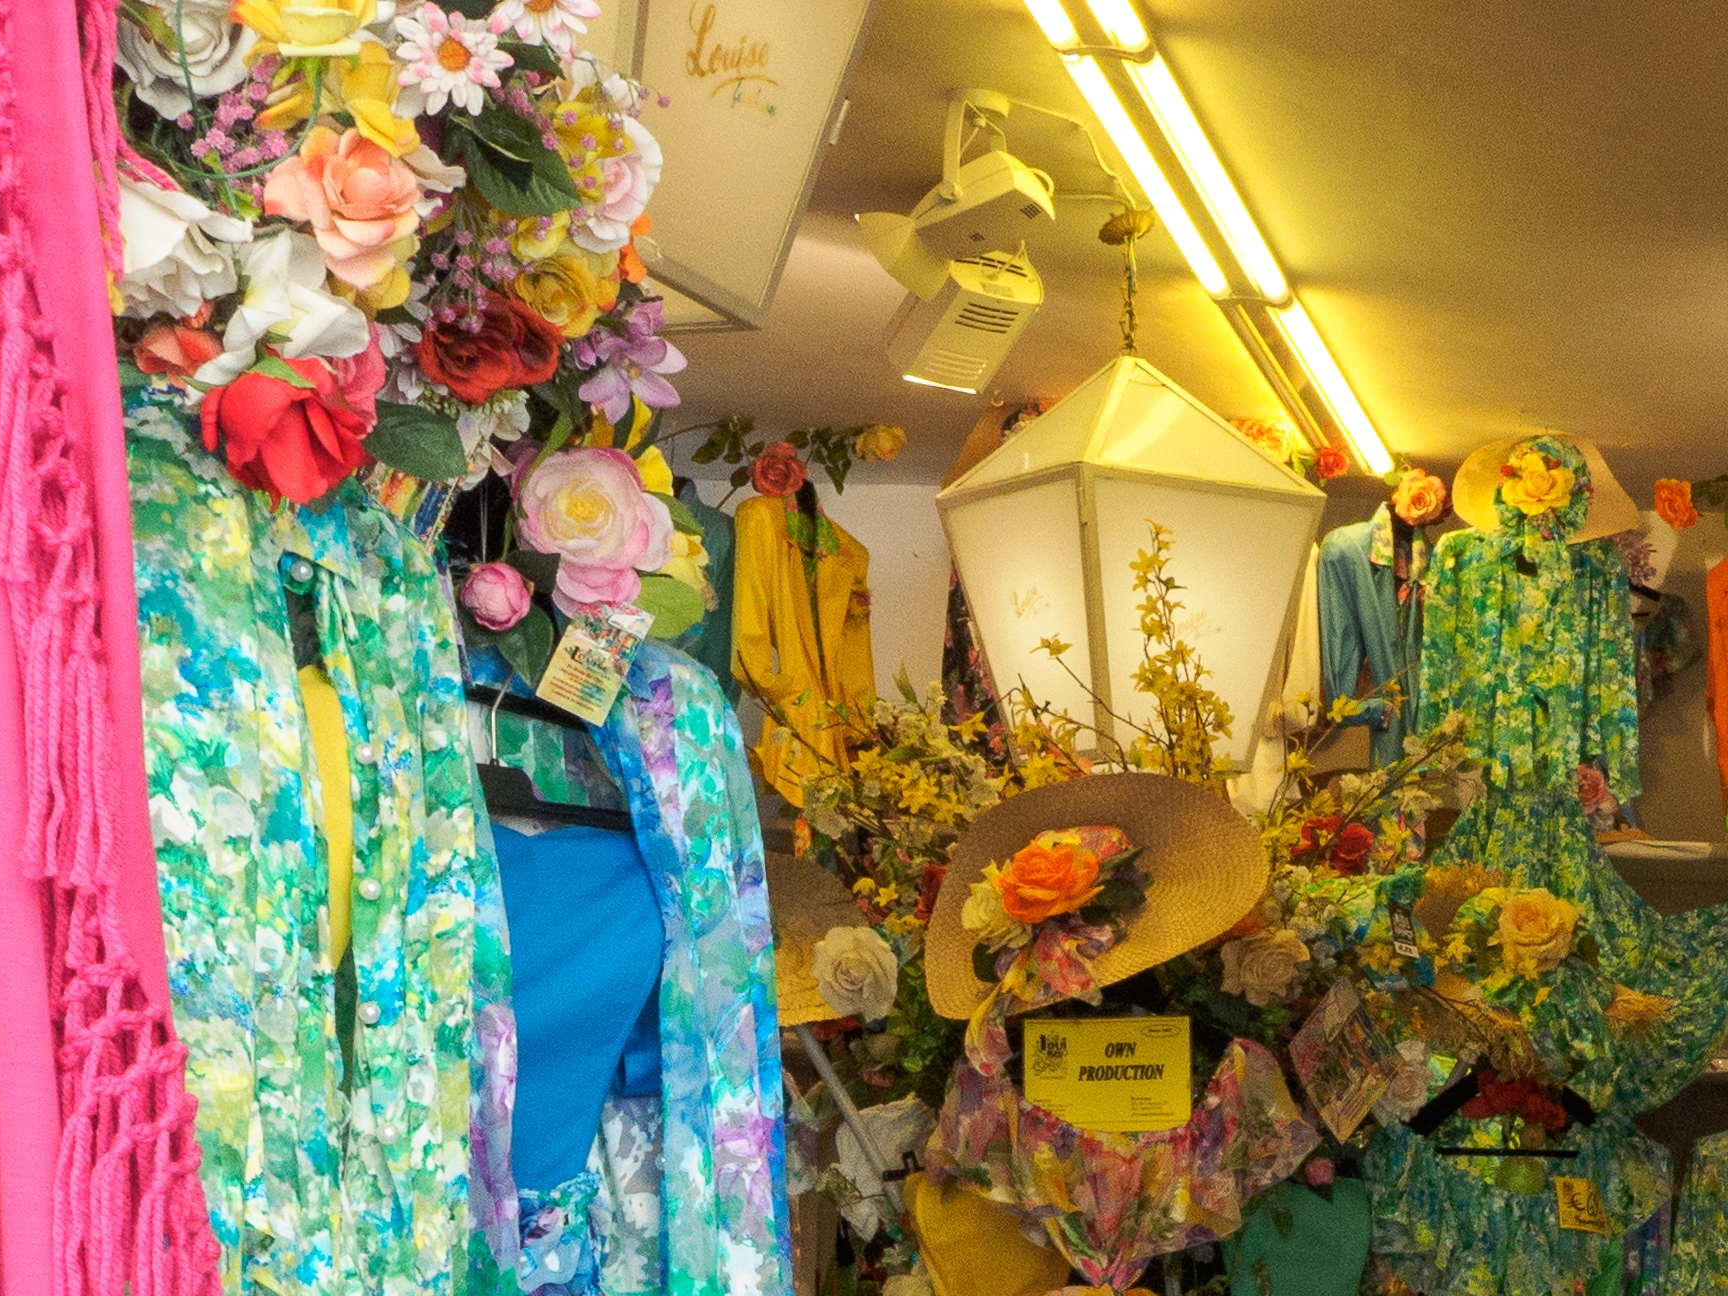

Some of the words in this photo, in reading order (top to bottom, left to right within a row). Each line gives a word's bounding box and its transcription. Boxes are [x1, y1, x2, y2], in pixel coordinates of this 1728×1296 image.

[685, 0, 769, 78] Louise
[1104, 1042, 1137, 1059] OWN
[1077, 1063, 1165, 1082] PRODUCTION
